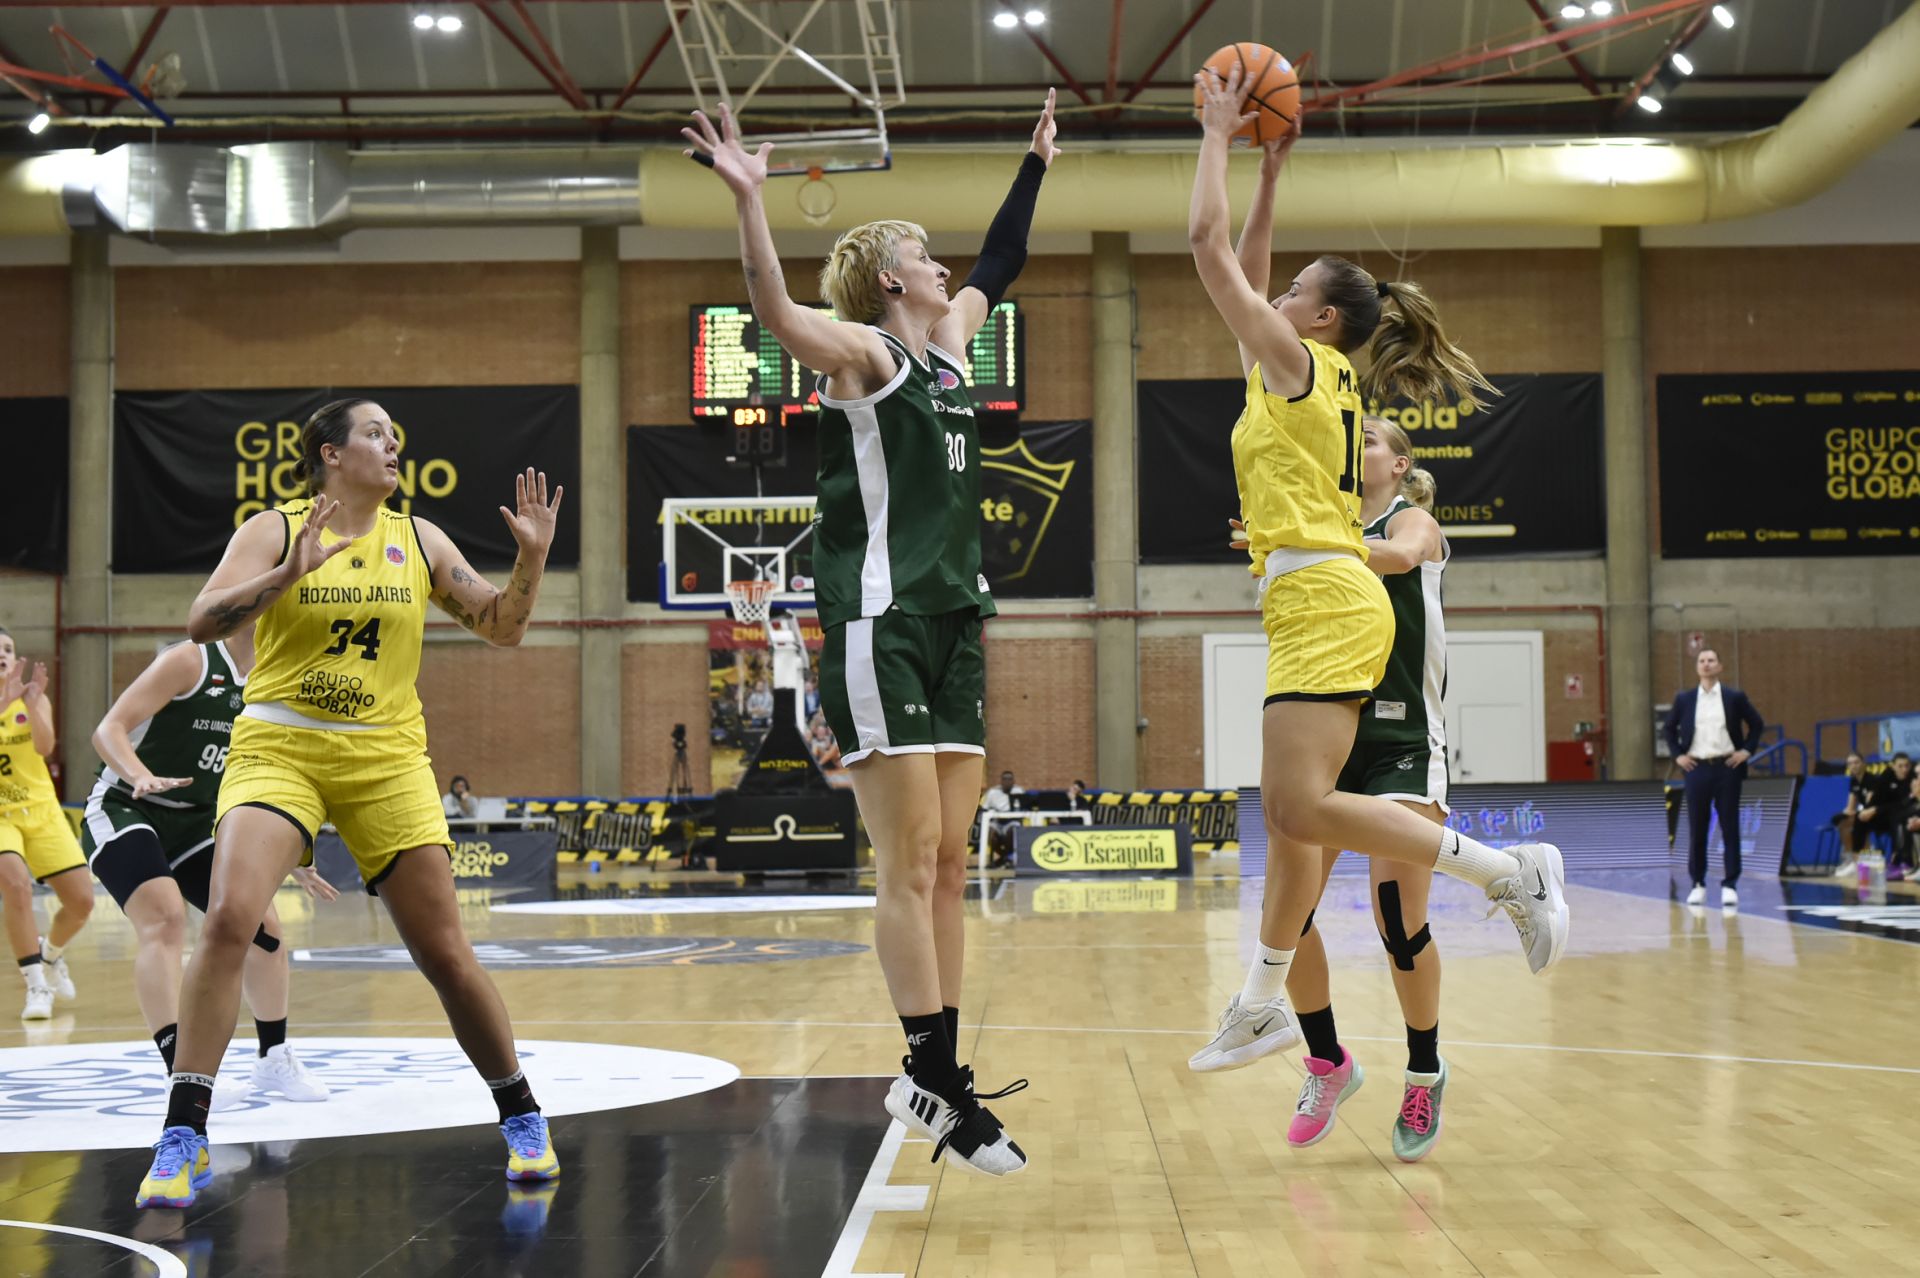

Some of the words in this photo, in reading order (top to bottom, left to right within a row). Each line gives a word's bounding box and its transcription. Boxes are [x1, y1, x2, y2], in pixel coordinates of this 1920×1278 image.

[945, 431, 966, 473] 30
[1828, 451, 1920, 475] HOZO
[236, 459, 458, 499] HONO
[299, 587, 362, 604] HOZONO
[366, 586, 412, 603] JAIRIS
[324, 617, 381, 661] 34
[303, 670, 362, 691] GRUPO
[301, 683, 375, 707] HOZONO
[192, 719, 210, 730] AZS
[197, 743, 229, 774] 95
[1084, 841, 1164, 869] Escayola
